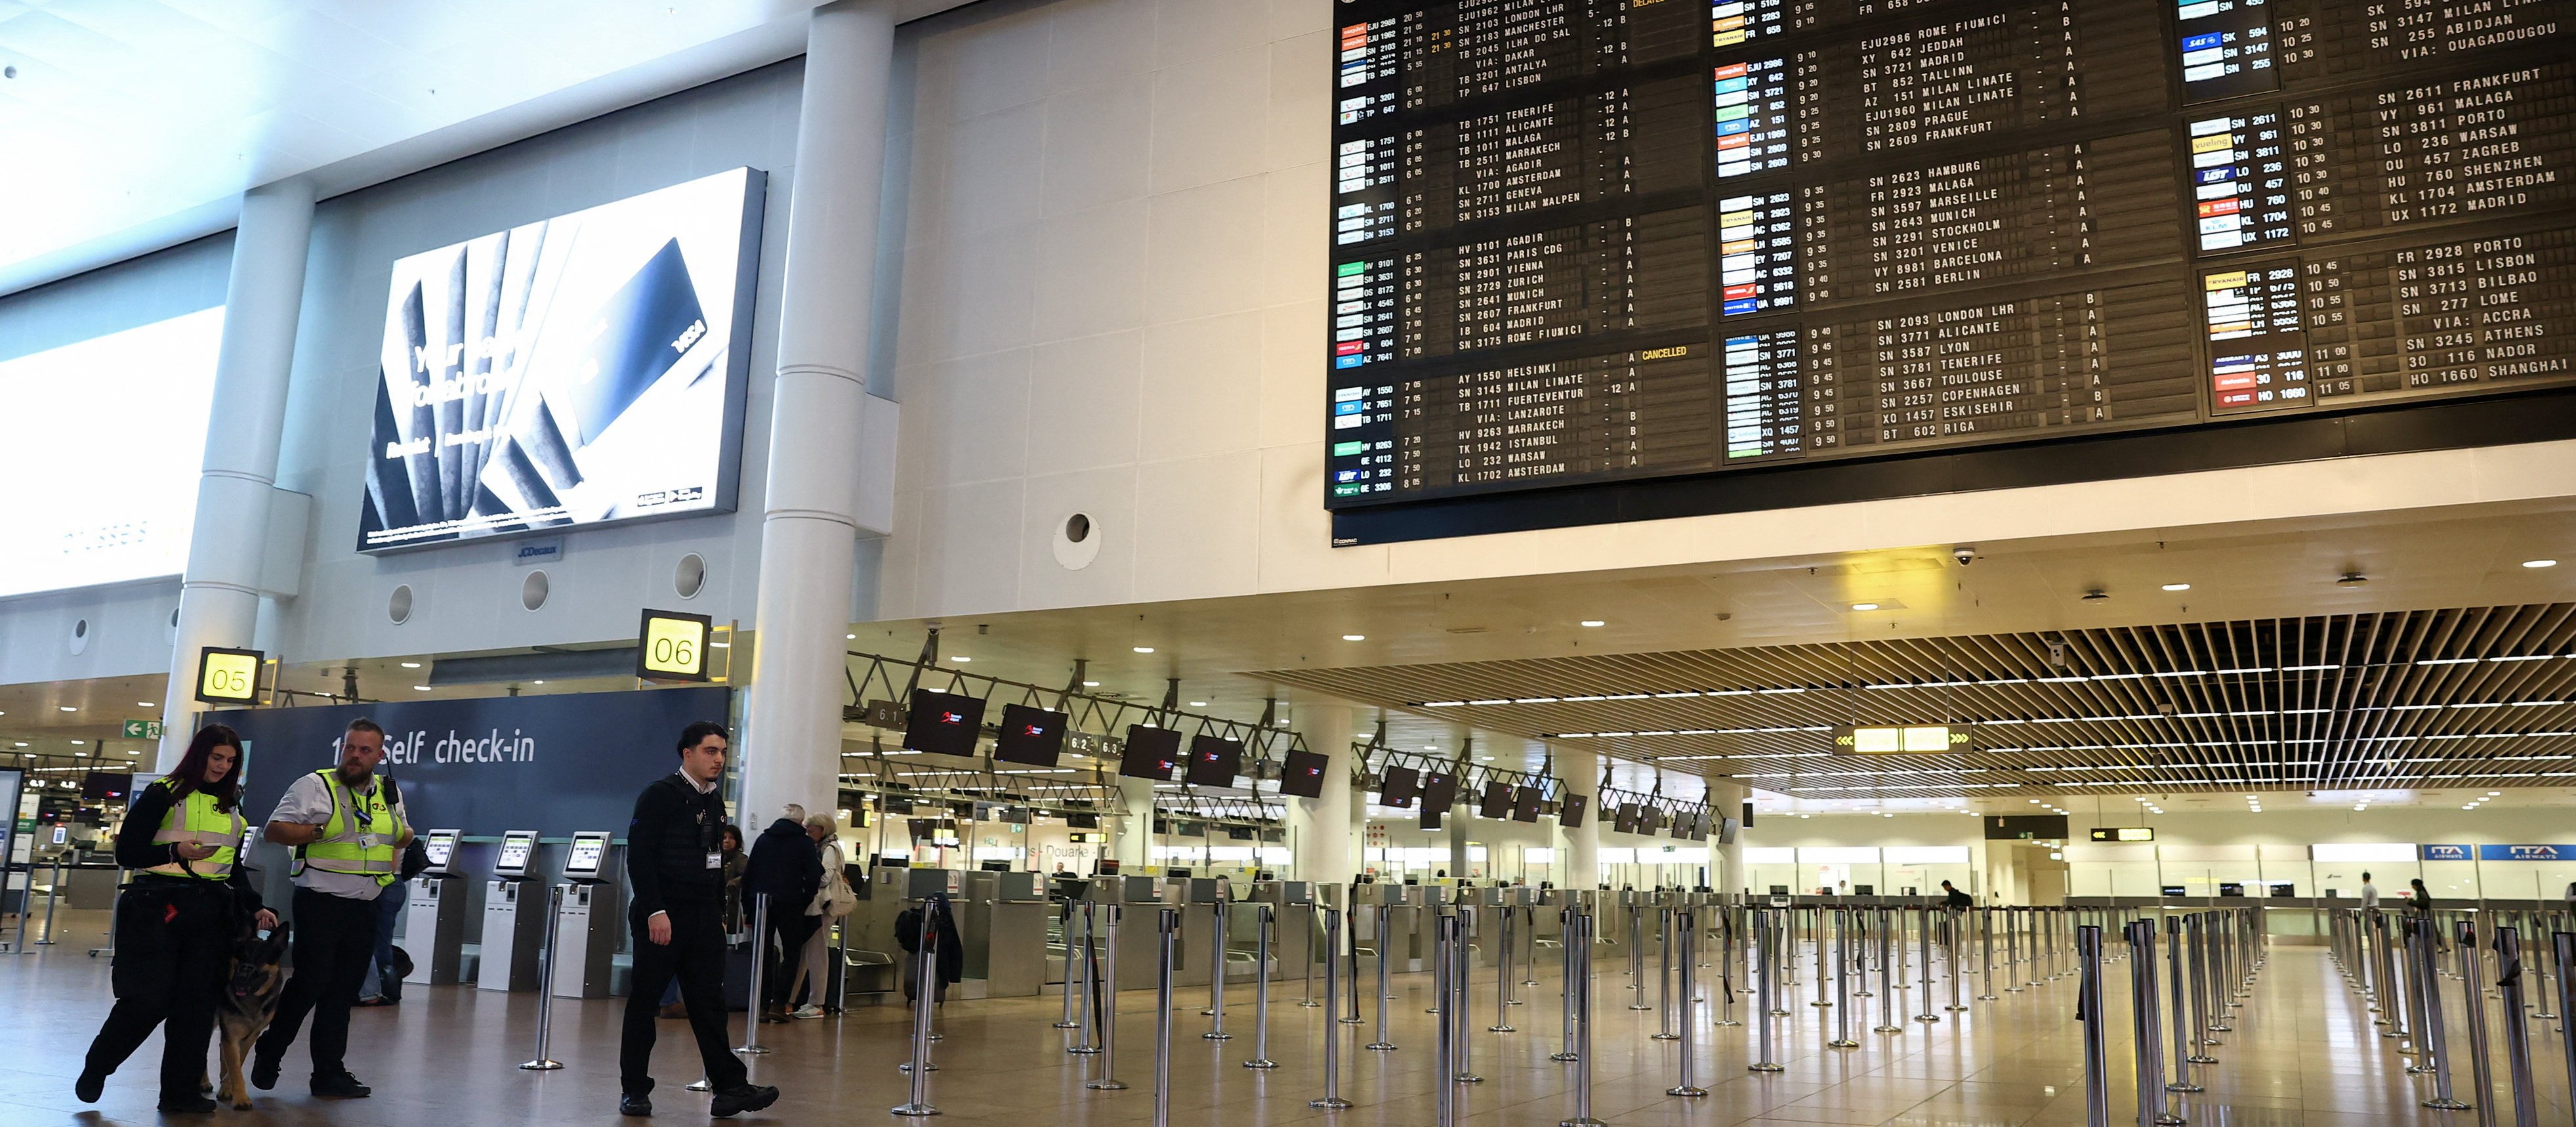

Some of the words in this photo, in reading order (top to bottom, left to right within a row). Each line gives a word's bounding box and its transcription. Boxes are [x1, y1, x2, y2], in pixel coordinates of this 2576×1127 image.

[1459, 6, 1498, 22] EJU1962
[1505, 0, 1533, 11] MILAN
[1459, 25, 1469, 34] SN
[1476, 18, 1498, 30] 2103
[1505, 9, 1539, 24] LONDON
[1547, 3, 1564, 14] LHR
[2370, 20, 2387, 32] SN
[2398, 12, 2432, 27] 3147
[2444, 1, 2491, 18] MILAN
[1505, 16, 1564, 36] MANCHESTER
[1861, 33, 1910, 50] EJU2986
[1919, 26, 1947, 39] ROME
[1956, 14, 2005, 32] FIUMICI
[2446, 14, 2512, 35] ABIDJAN
[1431, 32, 1440, 41] 21
[1506, 37, 1528, 49] ILHA
[1535, 33, 1546, 43] DO
[1553, 28, 1570, 39] SAL
[2449, 23, 2556, 51] OUAGADOUGOU
[1505, 49, 1534, 62] DAKAR
[1862, 54, 1875, 64] XY
[1891, 47, 1911, 59] 642
[1920, 37, 1963, 53] JEDDAH
[1505, 59, 1547, 75] ANTALYA
[1921, 52, 1964, 68] MADRID
[1380, 68, 1396, 77] 2045
[1506, 74, 1541, 88] LISBON
[1864, 83, 1877, 93] BT
[1893, 76, 1913, 87] 852
[1921, 65, 1972, 82] TALLINN
[2454, 68, 2539, 92] FRANKFURT
[1922, 82, 1959, 96] MILAN
[1968, 72, 2012, 89] LINATE
[1923, 96, 1960, 112] MILAN
[1968, 87, 2013, 104] LINATE
[2455, 91, 2513, 109] MALAGA
[1459, 121, 1470, 129] TB
[1477, 115, 1498, 126] 1751
[1506, 104, 1553, 120] TENERIFE
[1506, 117, 1553, 133] ALICANTE
[1925, 110, 1968, 126] PRAGUE
[2458, 109, 2504, 125] PORTO
[1926, 121, 1992, 140] FRANKFURT
[2292, 123, 2305, 135] 10
[2310, 121, 2321, 131] 30
[2459, 124, 2517, 142] WARSAW
[1506, 133, 1541, 146] MALAGA
[2195, 137, 2228, 148] vueling
[1506, 142, 1560, 159] MARRAKECH
[2462, 142, 2519, 159] ZAGREB
[1506, 159, 1541, 173] AGADIR
[1928, 161, 1980, 178] HAMBURG
[2388, 176, 2405, 188] HU
[2426, 169, 2453, 182] 760
[2464, 156, 2542, 177] SHENZHEN
[1459, 186, 1470, 195] KL
[1477, 181, 1500, 192] 1700
[1506, 169, 1561, 186] AMSTERDAM
[2203, 169, 2229, 181] LOT
[2467, 171, 2555, 194] AMSTERDAM
[1506, 186, 1542, 200] GENEVA
[1871, 192, 1884, 202] FR
[1893, 186, 1921, 198] 2923
[1929, 177, 1974, 192] MALAGA
[1506, 200, 1536, 213] MILAN
[1543, 192, 1579, 207] MALPEN
[1930, 189, 1997, 208] MARSEILLE
[2467, 193, 2526, 211] MADRID
[1930, 207, 1976, 223] MUNICH
[1932, 219, 2000, 238] STOCKHOLM
[1459, 245, 1470, 255] HV
[1477, 240, 1499, 251] 9101
[1506, 233, 1543, 247] AGADIR
[1507, 247, 1537, 261] PARIS
[1544, 244, 1562, 255] CDG
[1932, 238, 1978, 253] VENICE
[2398, 251, 2415, 263] FR
[2425, 245, 2462, 260] 2928
[2474, 238, 2522, 253] PORTO
[1507, 261, 1543, 274] VIENNA
[1934, 251, 2002, 268] BARCELONA
[2476, 253, 2535, 270] LISBON
[1508, 274, 1543, 287] ZURICH
[1935, 269, 1980, 284] BERLIN
[2247, 272, 2260, 283] FR
[2268, 268, 2294, 280] 2928
[2478, 271, 2537, 288] BILBAO
[1507, 288, 1544, 301] MUNICH
[2480, 291, 2518, 306] LOME
[1508, 299, 1562, 315] FRANKFURT
[1507, 316, 1544, 329] MADRID
[1878, 320, 1892, 330] SN
[1900, 315, 1929, 328] 2093
[1938, 308, 1983, 322] LONDON
[1992, 304, 2014, 316] LHR
[2433, 316, 2470, 329] VIA:
[2483, 308, 2531, 323] ACCRA
[671, 319, 705, 354] VISA
[1507, 331, 1531, 343] ROME
[1539, 325, 1581, 339] FIUMICI
[1939, 322, 1999, 338] ALICANTE
[2407, 338, 2424, 350] SN
[2436, 333, 2472, 347] 3245
[2485, 325, 2543, 341] ATHENS
[1642, 347, 1687, 360] CANCELLED
[1940, 341, 1969, 354] LYON
[2486, 344, 2535, 359] NADOR
[1940, 354, 2001, 370] TENERIFE
[1459, 374, 1470, 384] AY
[1477, 371, 1501, 381] 1550
[1507, 363, 1555, 377] HELSINKI
[1942, 370, 2003, 385] TOULOUSE
[2411, 373, 2428, 385] HO
[2440, 368, 2477, 381] 1660
[2489, 358, 2567, 377] SHANGHAI
[1508, 380, 1538, 392] MILAN
[1546, 374, 1583, 387] LINATE
[1508, 389, 1583, 406] FUERTEVENTUR
[1942, 384, 2020, 401] COPENHAGEN
[1477, 414, 1501, 423] VIA:
[1508, 405, 1564, 420] LANZAROTE
[1943, 401, 2012, 417] ESKISEHIR
[1508, 419, 1564, 434] MARRAKECH
[1944, 421, 1974, 433] RIGA
[1509, 435, 1558, 448] ISTANBUL
[1508, 451, 1545, 463] WARSAW
[1508, 463, 1564, 477] AMSTERDAM
[655, 638, 692, 665] 06
[213, 670, 246, 691] 05
[879, 708, 897, 722] 6.1
[378, 731, 426, 765] Self
[435, 728, 535, 764] check-in
[1071, 737, 1087, 750] 6.2
[1102, 742, 1117, 754] 6.3
[2510, 845, 2558, 854] ITA
